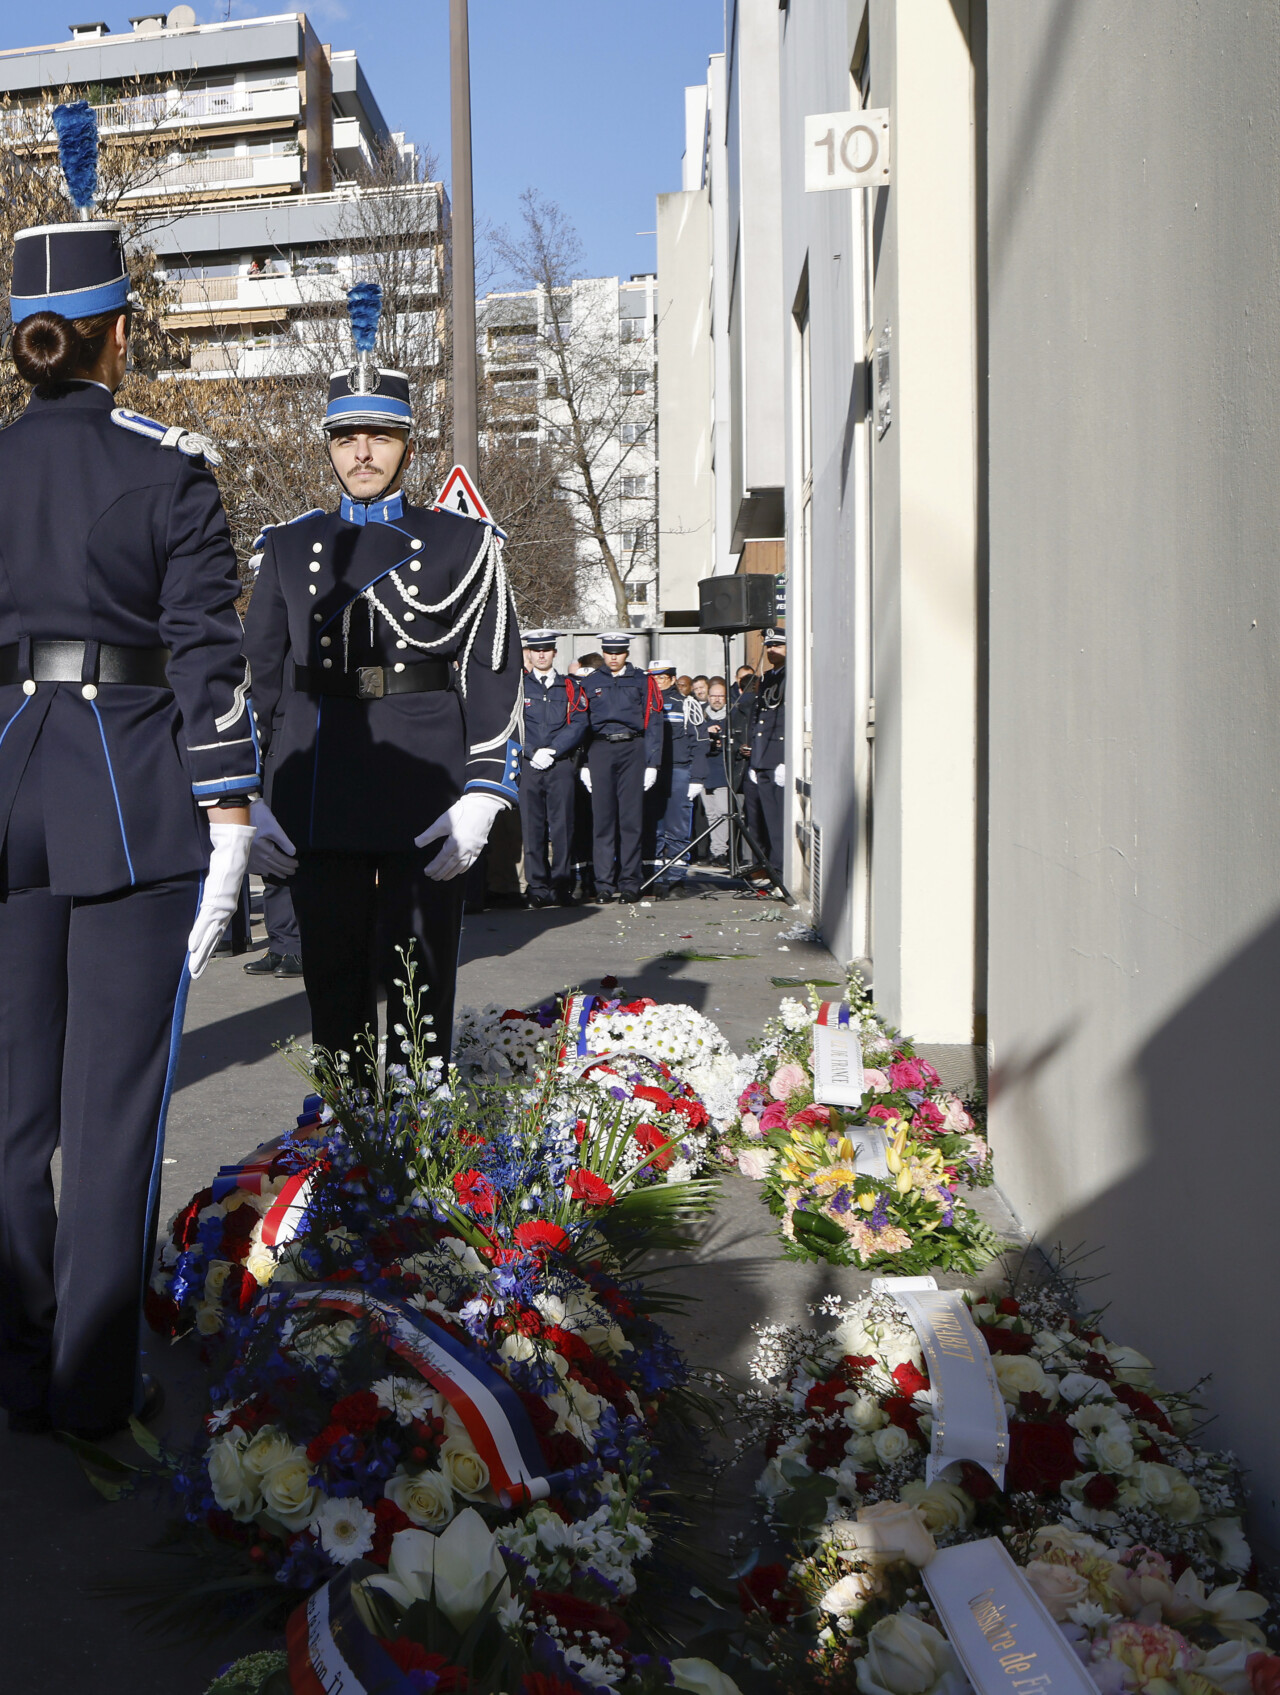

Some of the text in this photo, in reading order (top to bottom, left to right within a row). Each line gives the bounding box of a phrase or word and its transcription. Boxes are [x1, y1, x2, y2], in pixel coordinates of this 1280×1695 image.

[814, 124, 879, 175] 10
[831, 1059, 849, 1084] FRANCE
[928, 1313, 975, 1363] MERABET
[967, 1587, 1053, 1695] Consistoire de Fr
